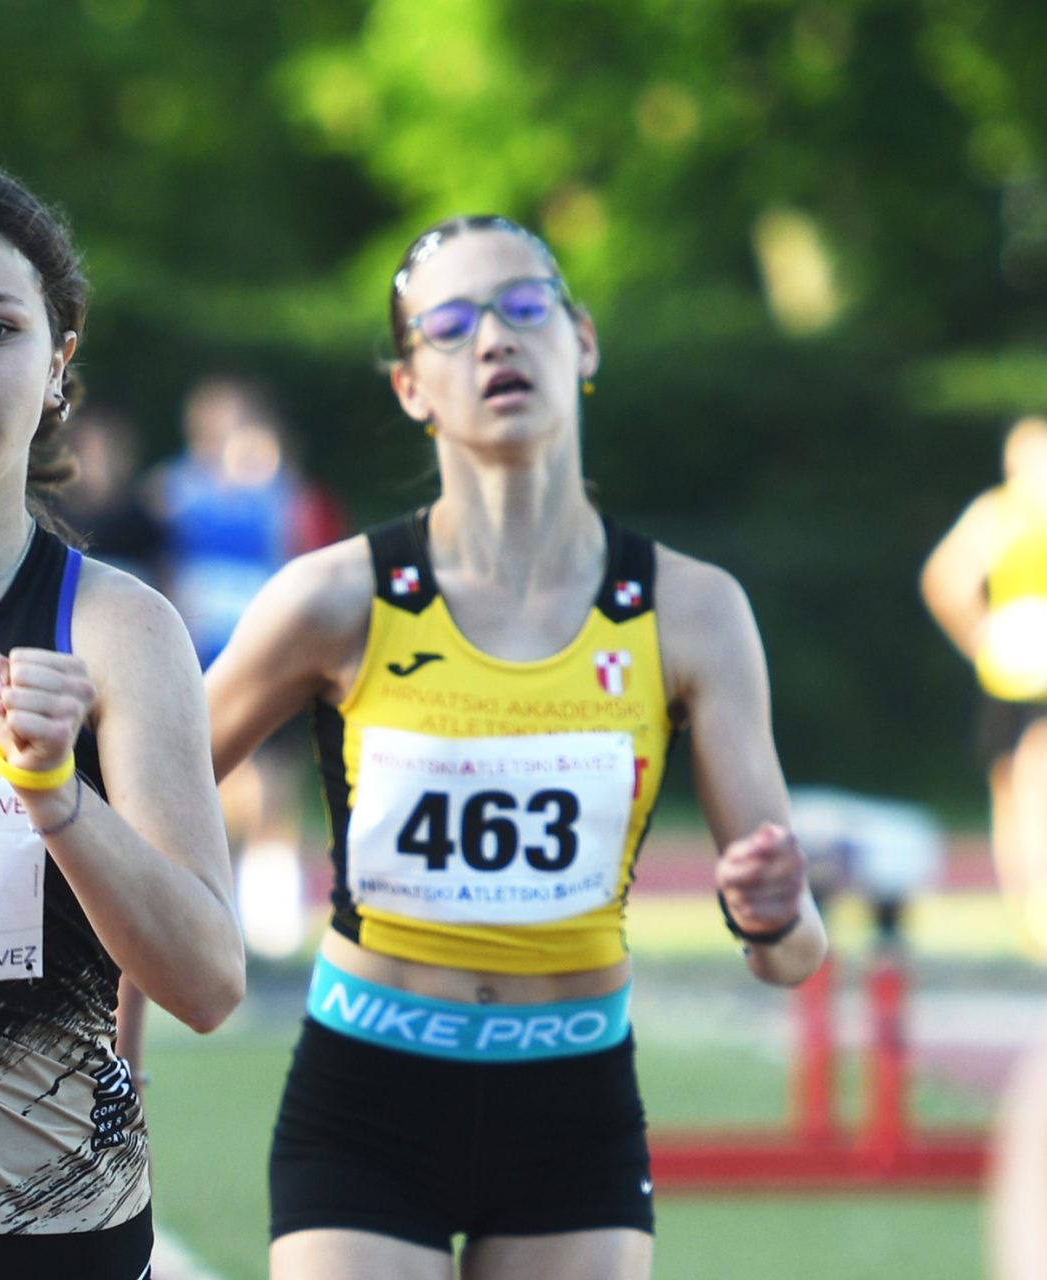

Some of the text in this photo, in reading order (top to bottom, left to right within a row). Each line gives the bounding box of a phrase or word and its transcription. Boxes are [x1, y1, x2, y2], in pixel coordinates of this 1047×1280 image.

[396, 787, 581, 873] 463
[321, 981, 608, 1050] NIKE PRO
